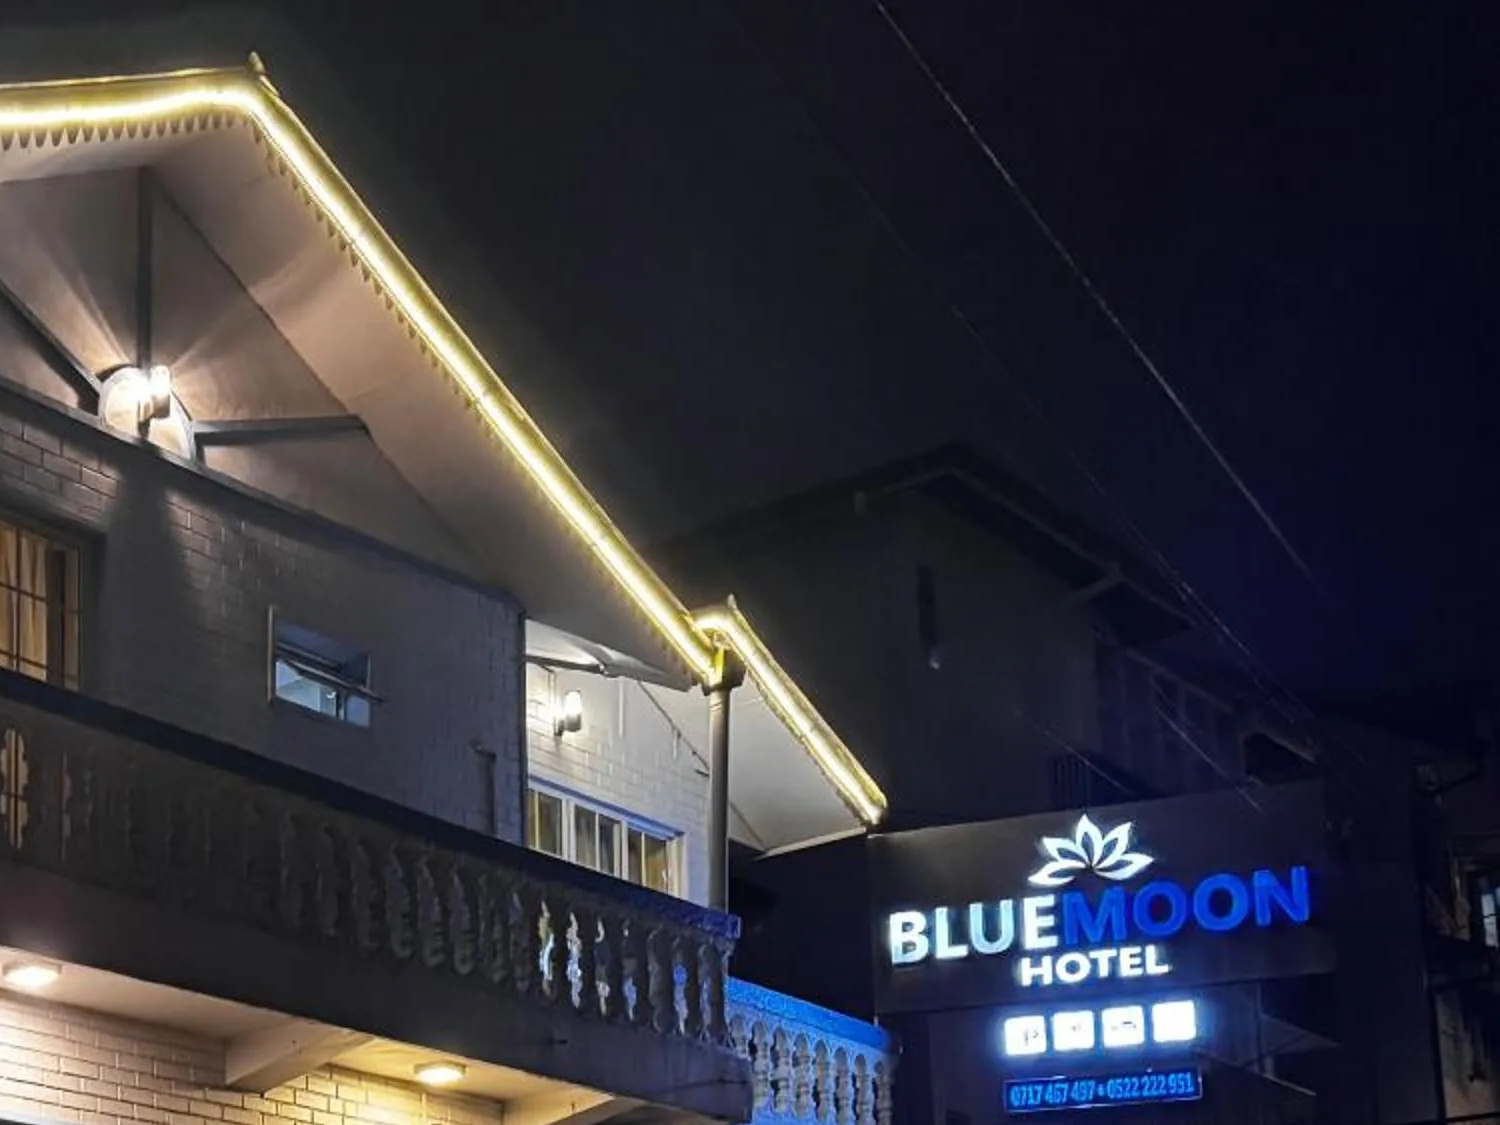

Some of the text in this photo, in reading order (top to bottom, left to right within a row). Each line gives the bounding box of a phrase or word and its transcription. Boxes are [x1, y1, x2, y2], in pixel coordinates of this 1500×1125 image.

[1019, 943, 1173, 987] HOTEL
[1107, 1077, 1140, 1099] 0522
[1141, 1074, 1167, 1097] 222
